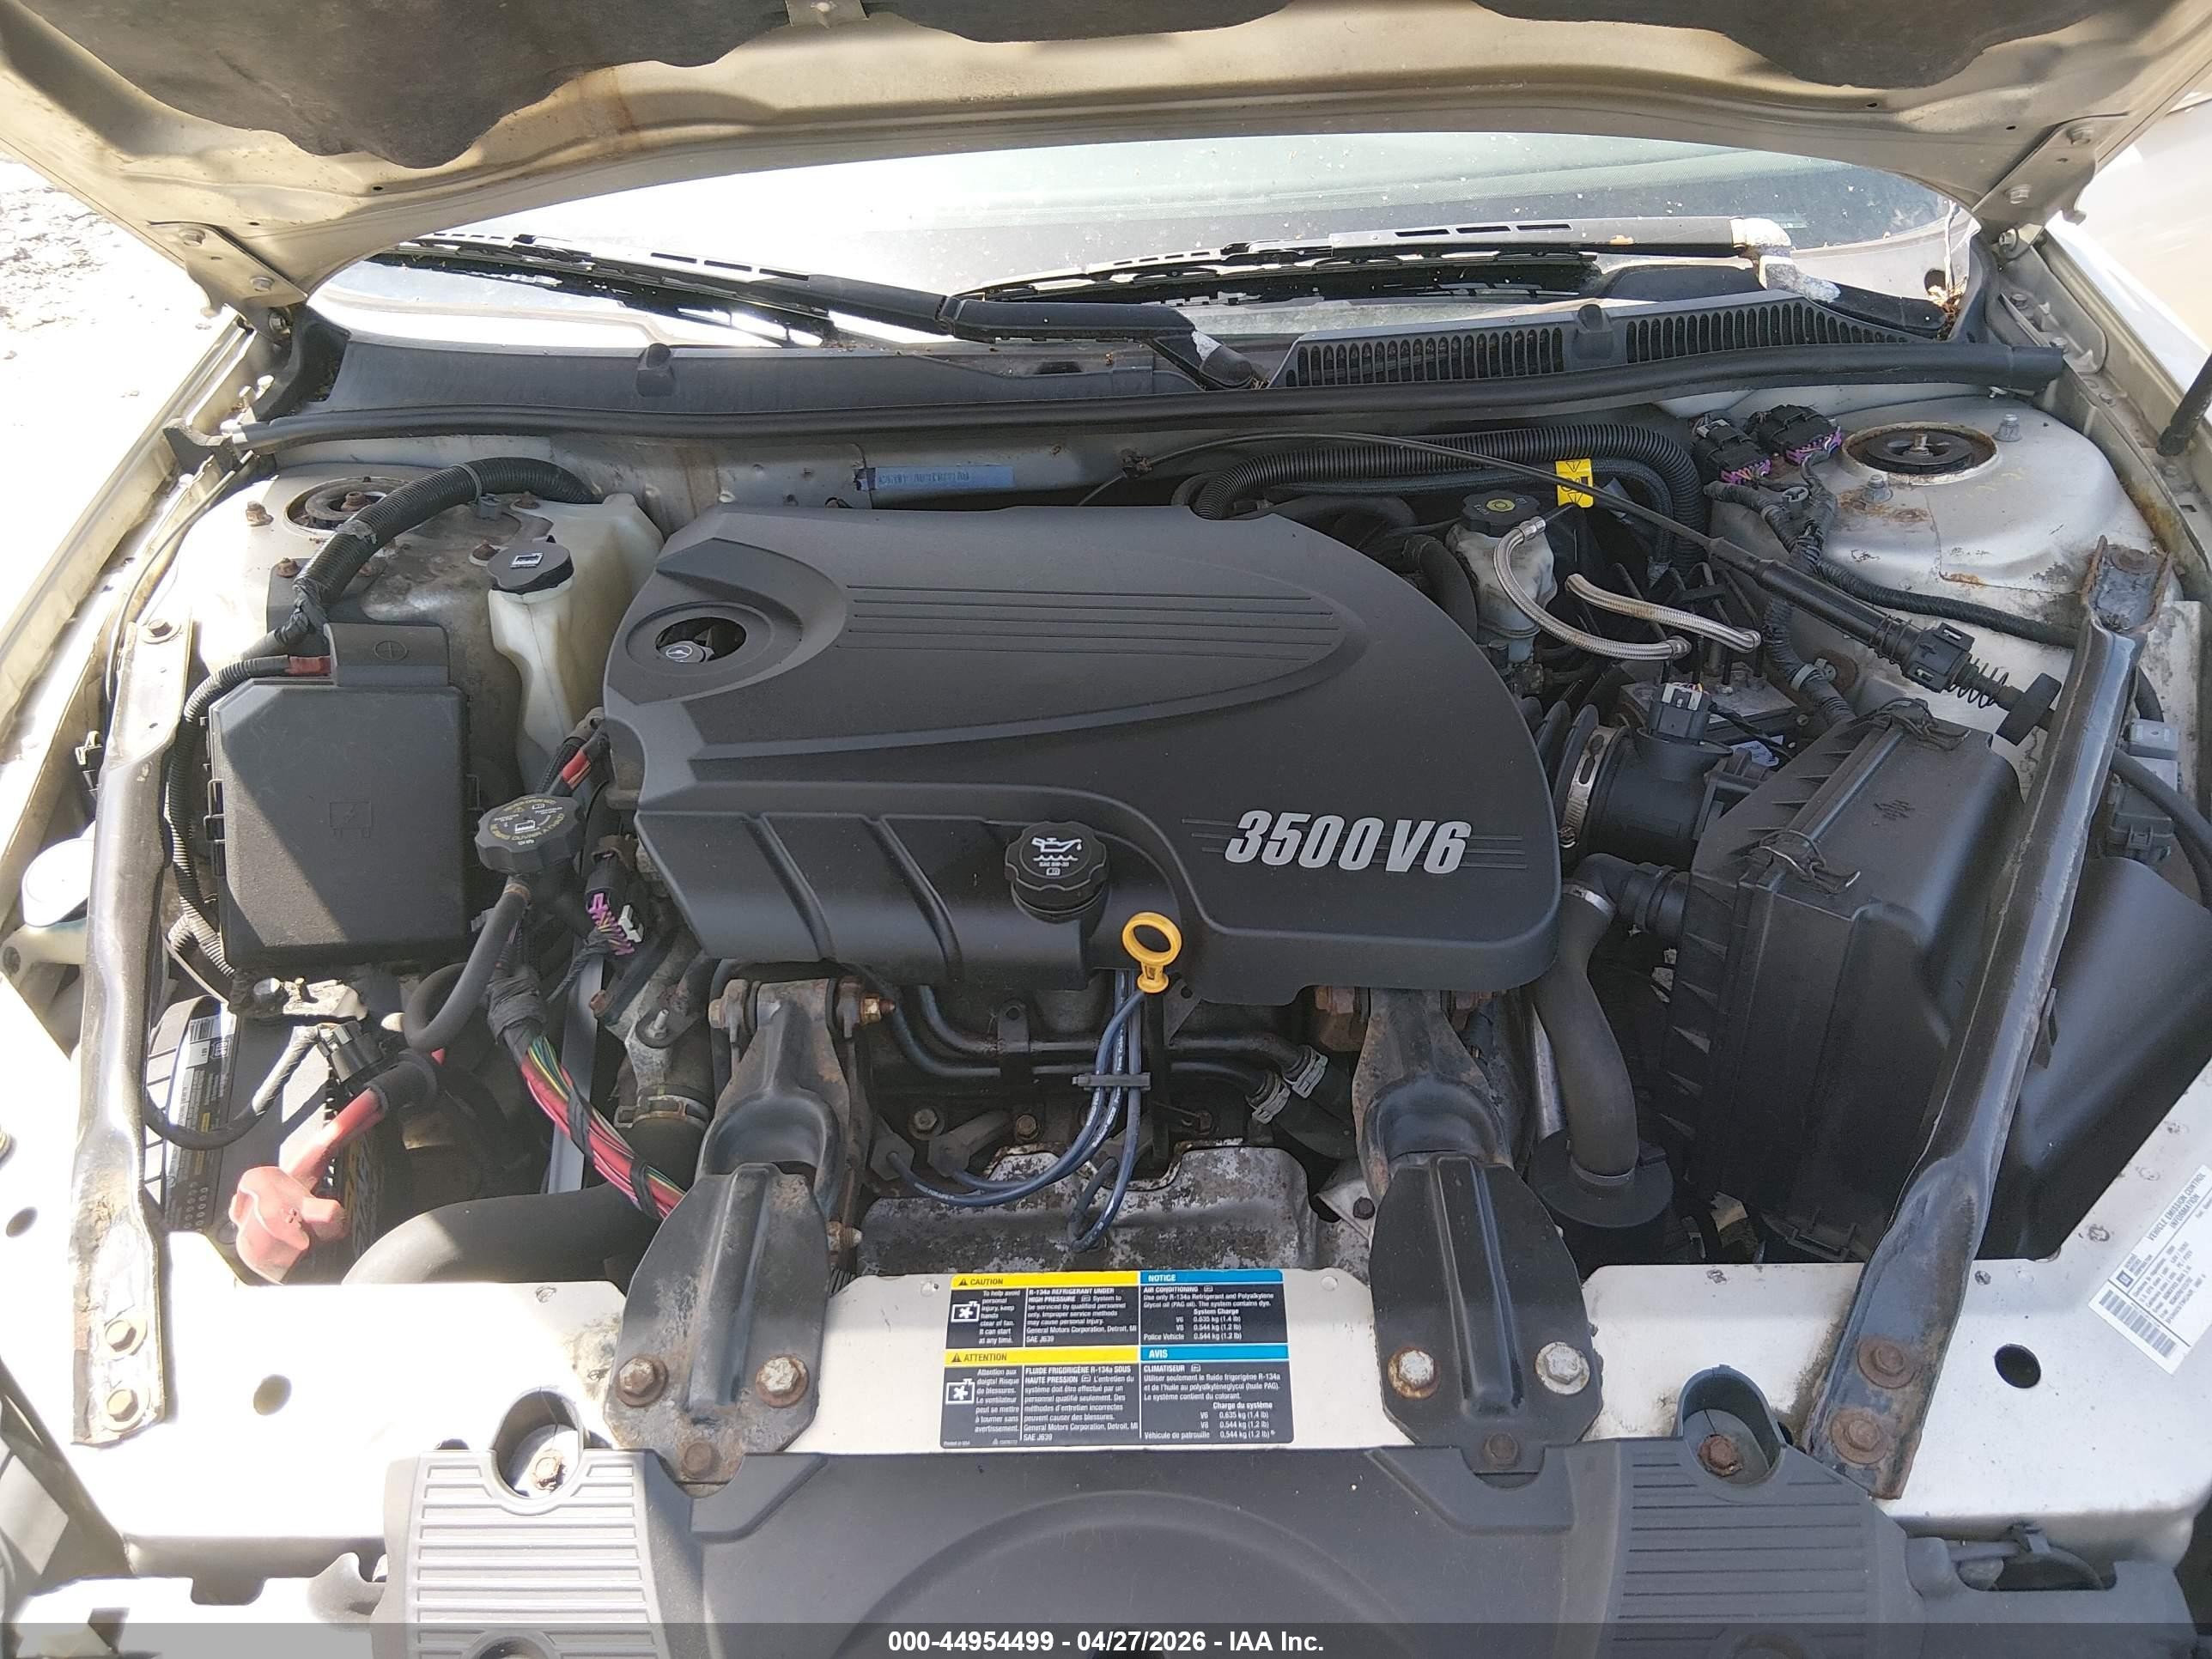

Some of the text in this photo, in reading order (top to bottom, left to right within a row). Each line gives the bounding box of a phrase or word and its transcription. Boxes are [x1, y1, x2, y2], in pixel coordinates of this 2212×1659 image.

[1224, 810, 1472, 874] 3500 V6
[2147, 1218, 2168, 1241] VEHICLE
[2166, 1194, 2185, 1220] EMISSION
[2185, 1173, 2206, 1196] CONTROL
[2170, 1194, 2200, 1229] INFORMATION
[1149, 1350, 1167, 1358] AVIS
